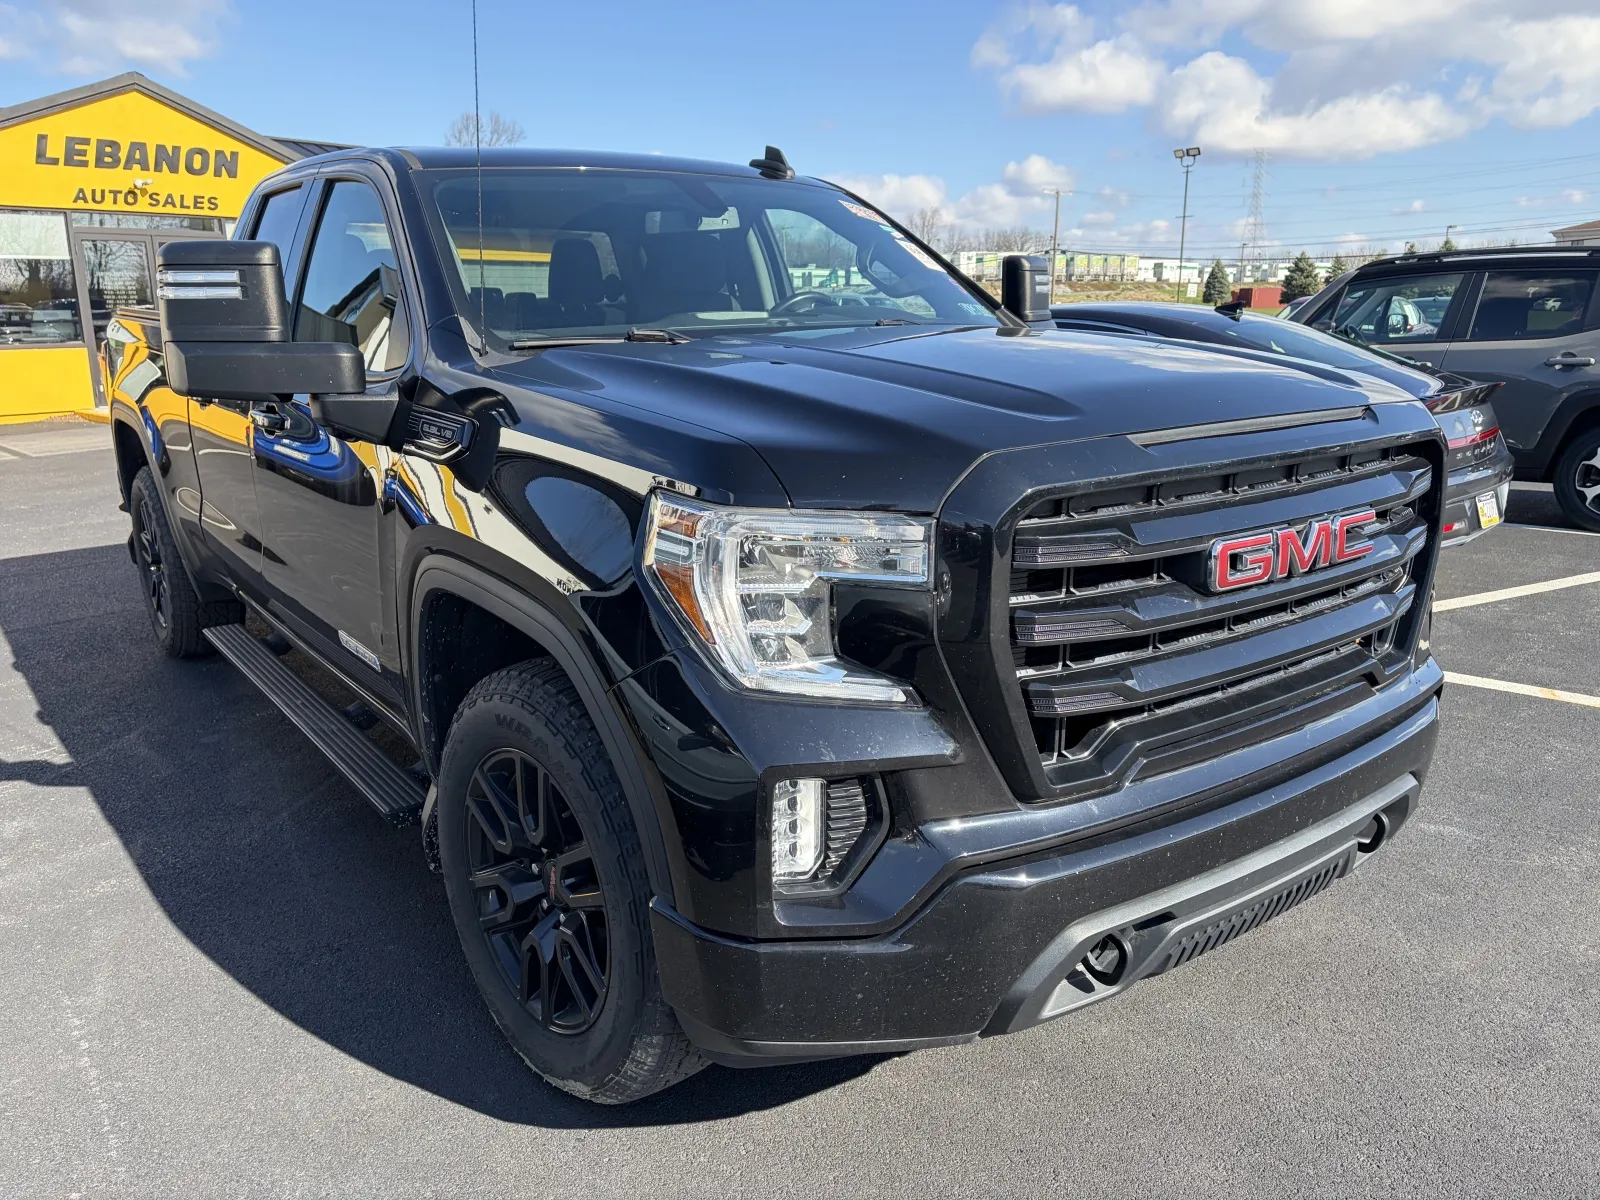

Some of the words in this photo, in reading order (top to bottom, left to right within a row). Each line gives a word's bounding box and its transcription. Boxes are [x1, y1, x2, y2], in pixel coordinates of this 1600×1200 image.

[35, 134, 239, 178] LEBANON
[72, 188, 138, 205] AUTO
[148, 193, 219, 211] SALES
[1207, 510, 1376, 592] GMC
